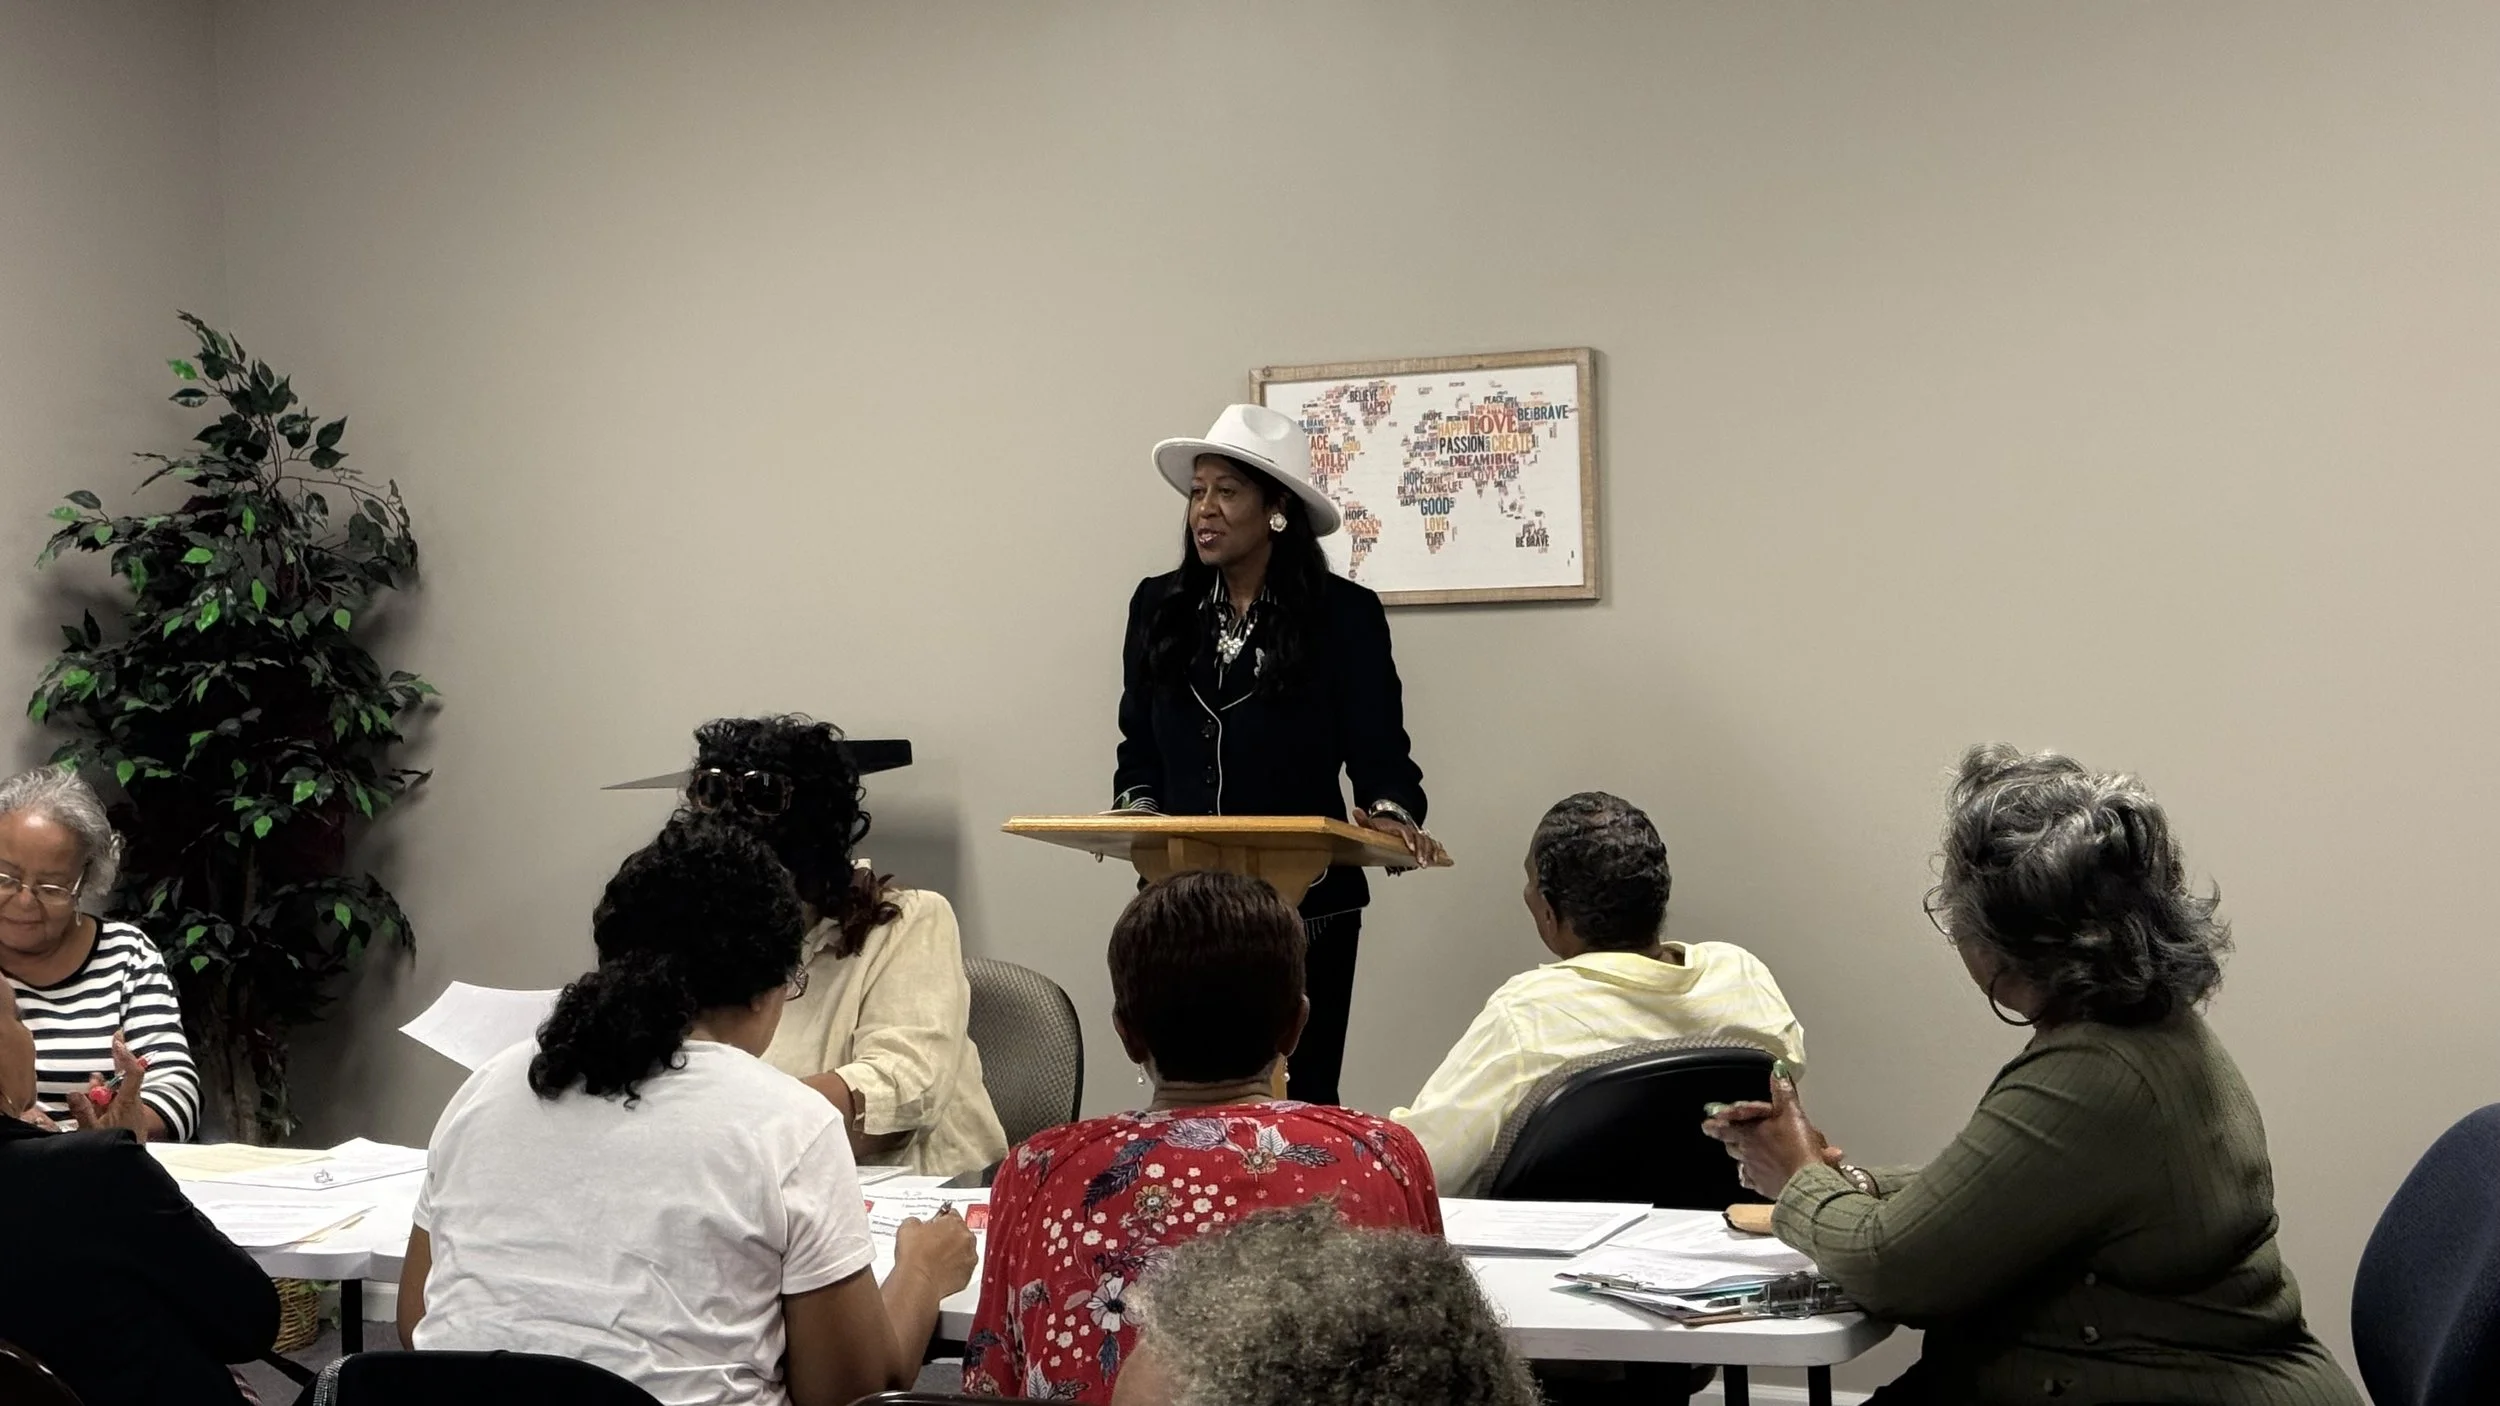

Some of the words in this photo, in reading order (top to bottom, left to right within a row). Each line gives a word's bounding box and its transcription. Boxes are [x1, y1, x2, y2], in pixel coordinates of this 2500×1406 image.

[1350, 388, 1378, 403] BELIEVE
[1360, 400, 1393, 415] HAPPY
[1518, 408, 1530, 422] BE
[1534, 405, 1569, 421] BRAVE
[1422, 411, 1443, 421] HOPE
[1438, 421, 1468, 436] HAPPY
[1469, 413, 1518, 435] LOVE
[1306, 434, 1329, 451] ACE
[1439, 435, 1485, 455] PASSION
[1492, 433, 1533, 453] CREATE
[1311, 453, 1345, 468] MILE
[1449, 454, 1490, 467] DREAM
[1404, 471, 1424, 485] HOPE
[1421, 496, 1450, 516] GOOD
[1345, 509, 1369, 521] HOPE
[1424, 516, 1447, 532] LOVE
[1516, 537, 1525, 548] BE
[1526, 535, 1550, 548] BRAVE
